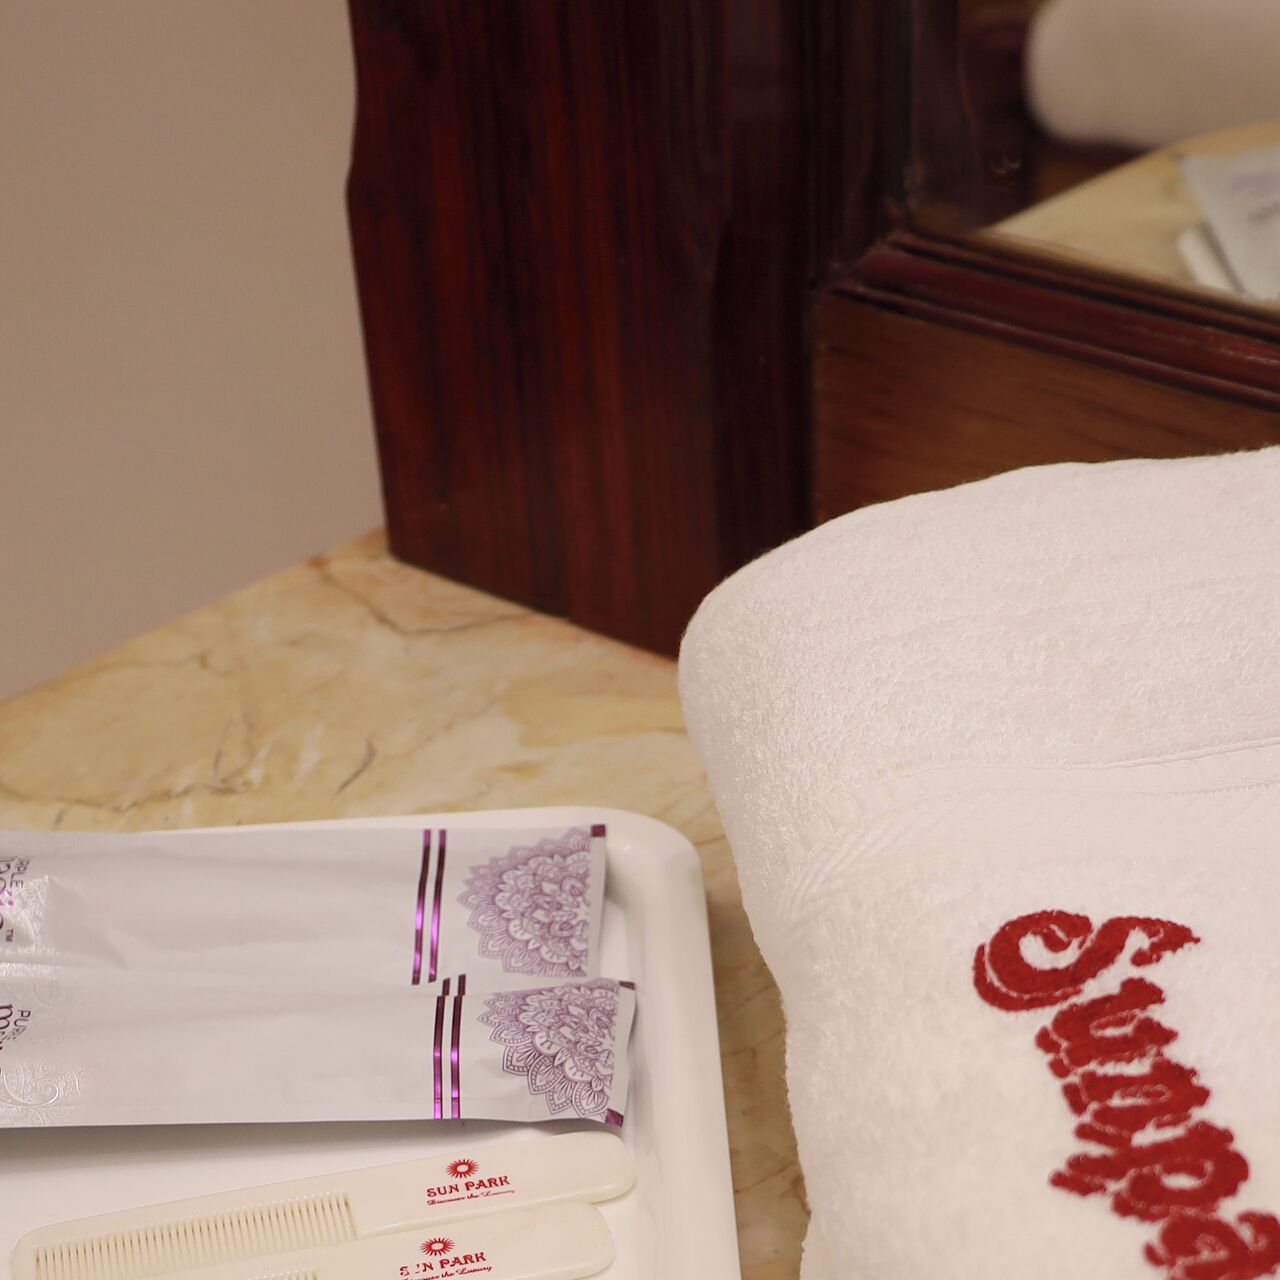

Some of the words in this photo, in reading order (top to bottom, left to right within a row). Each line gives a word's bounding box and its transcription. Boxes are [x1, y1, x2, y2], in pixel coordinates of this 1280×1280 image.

[426, 1184, 460, 1198] SUN
[464, 1175, 510, 1191] PARK
[439, 1252, 487, 1269] PARK
